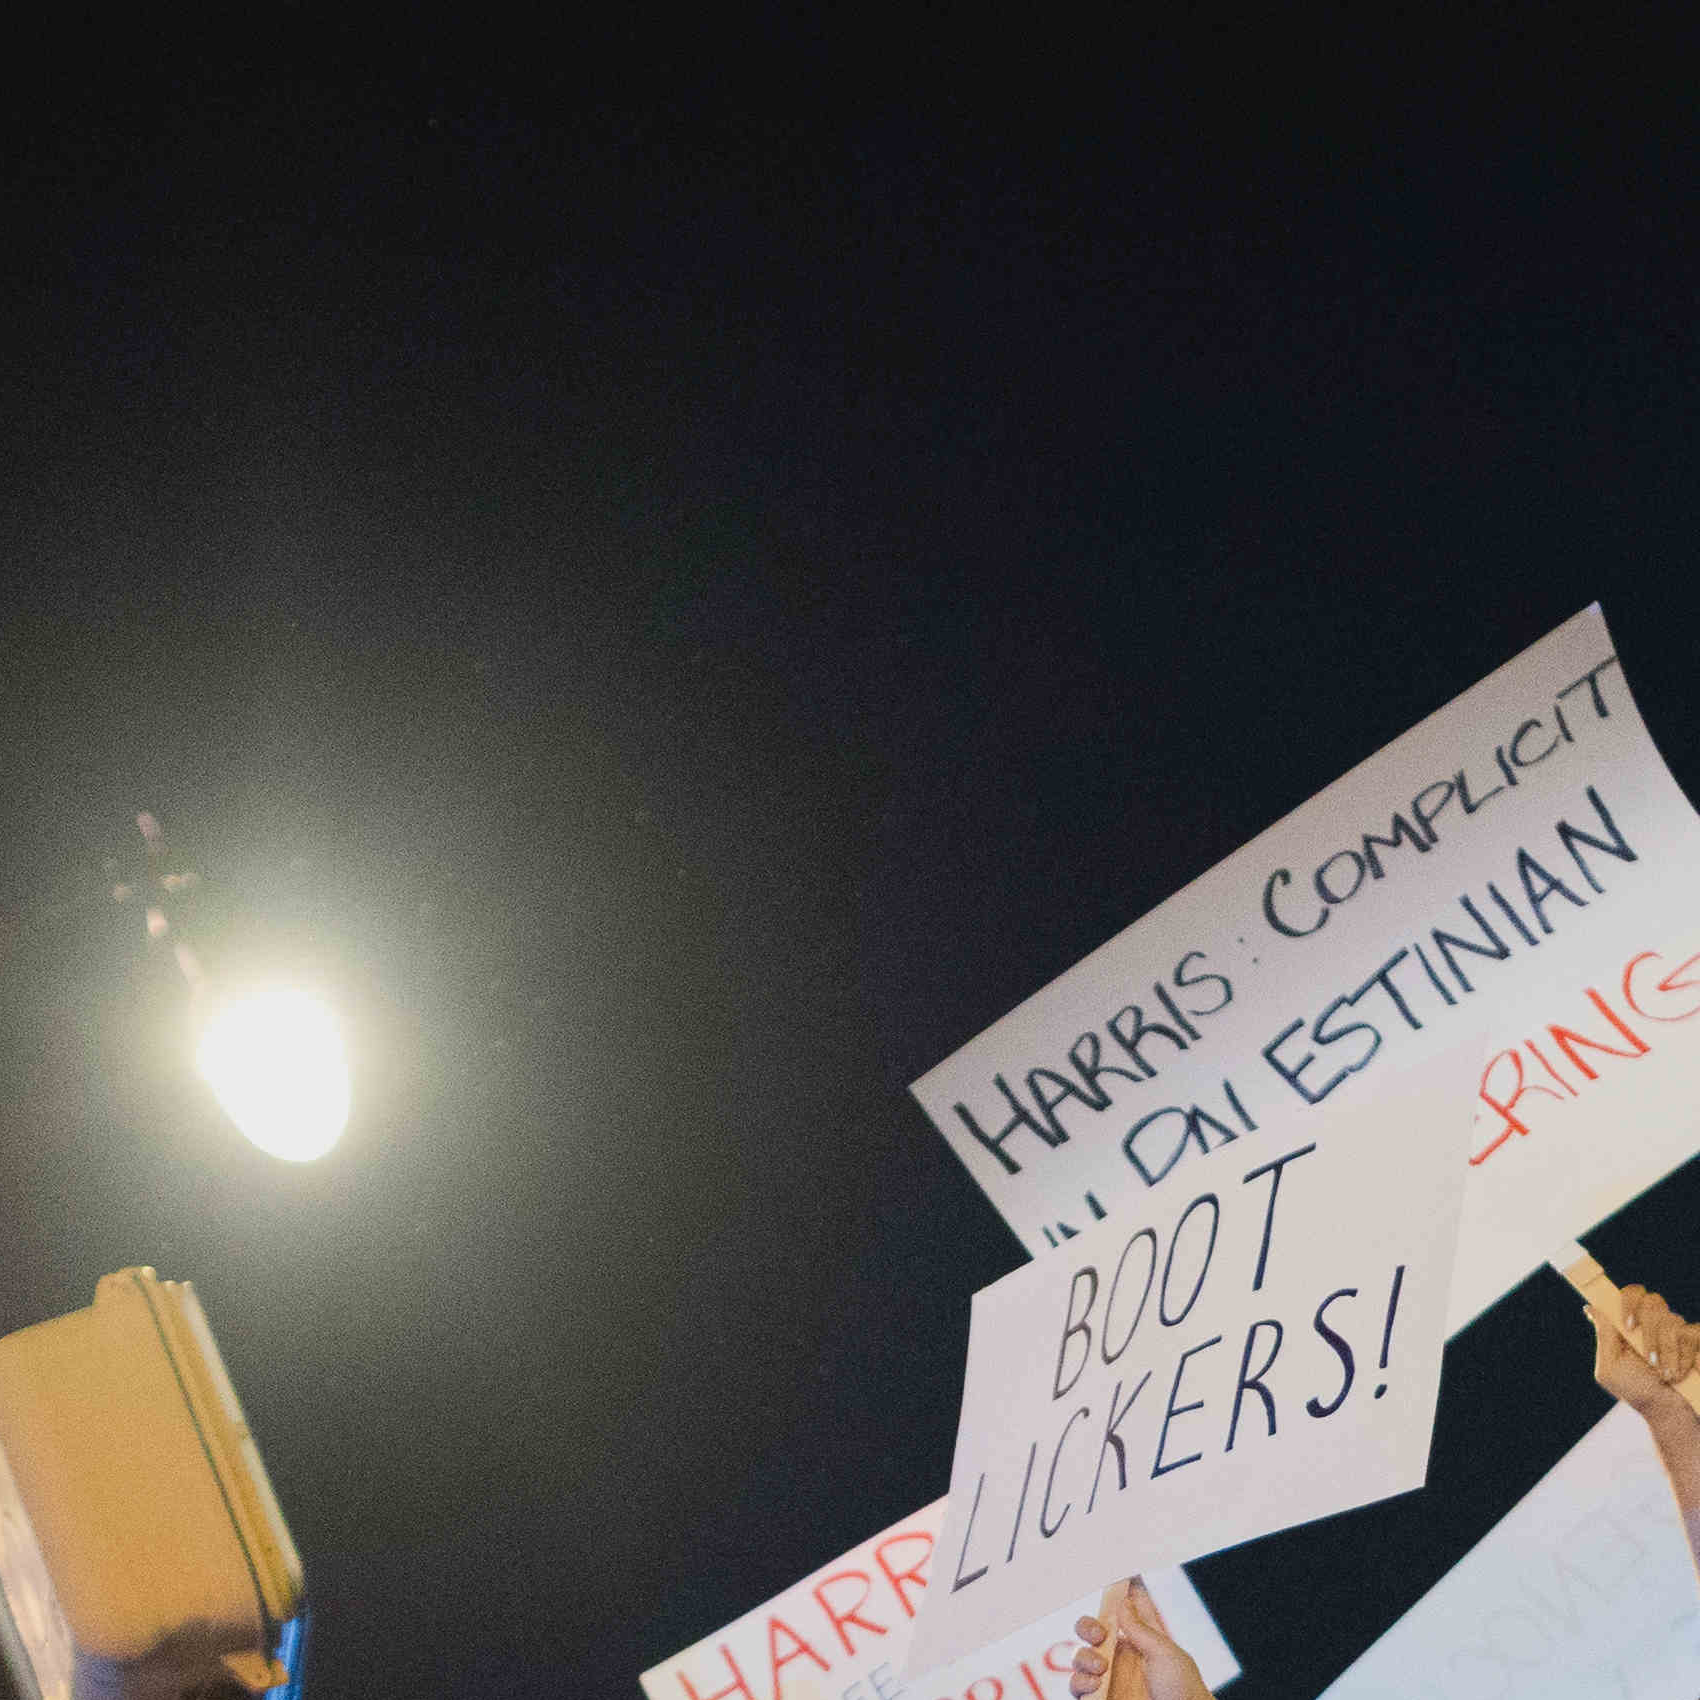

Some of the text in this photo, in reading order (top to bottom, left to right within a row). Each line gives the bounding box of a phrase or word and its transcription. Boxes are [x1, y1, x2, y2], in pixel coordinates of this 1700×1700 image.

[1263, 655, 1619, 939] COMPLICIT
[1051, 1143, 1317, 1402] BOOT
[951, 1264, 1405, 1594] LICKERS!
